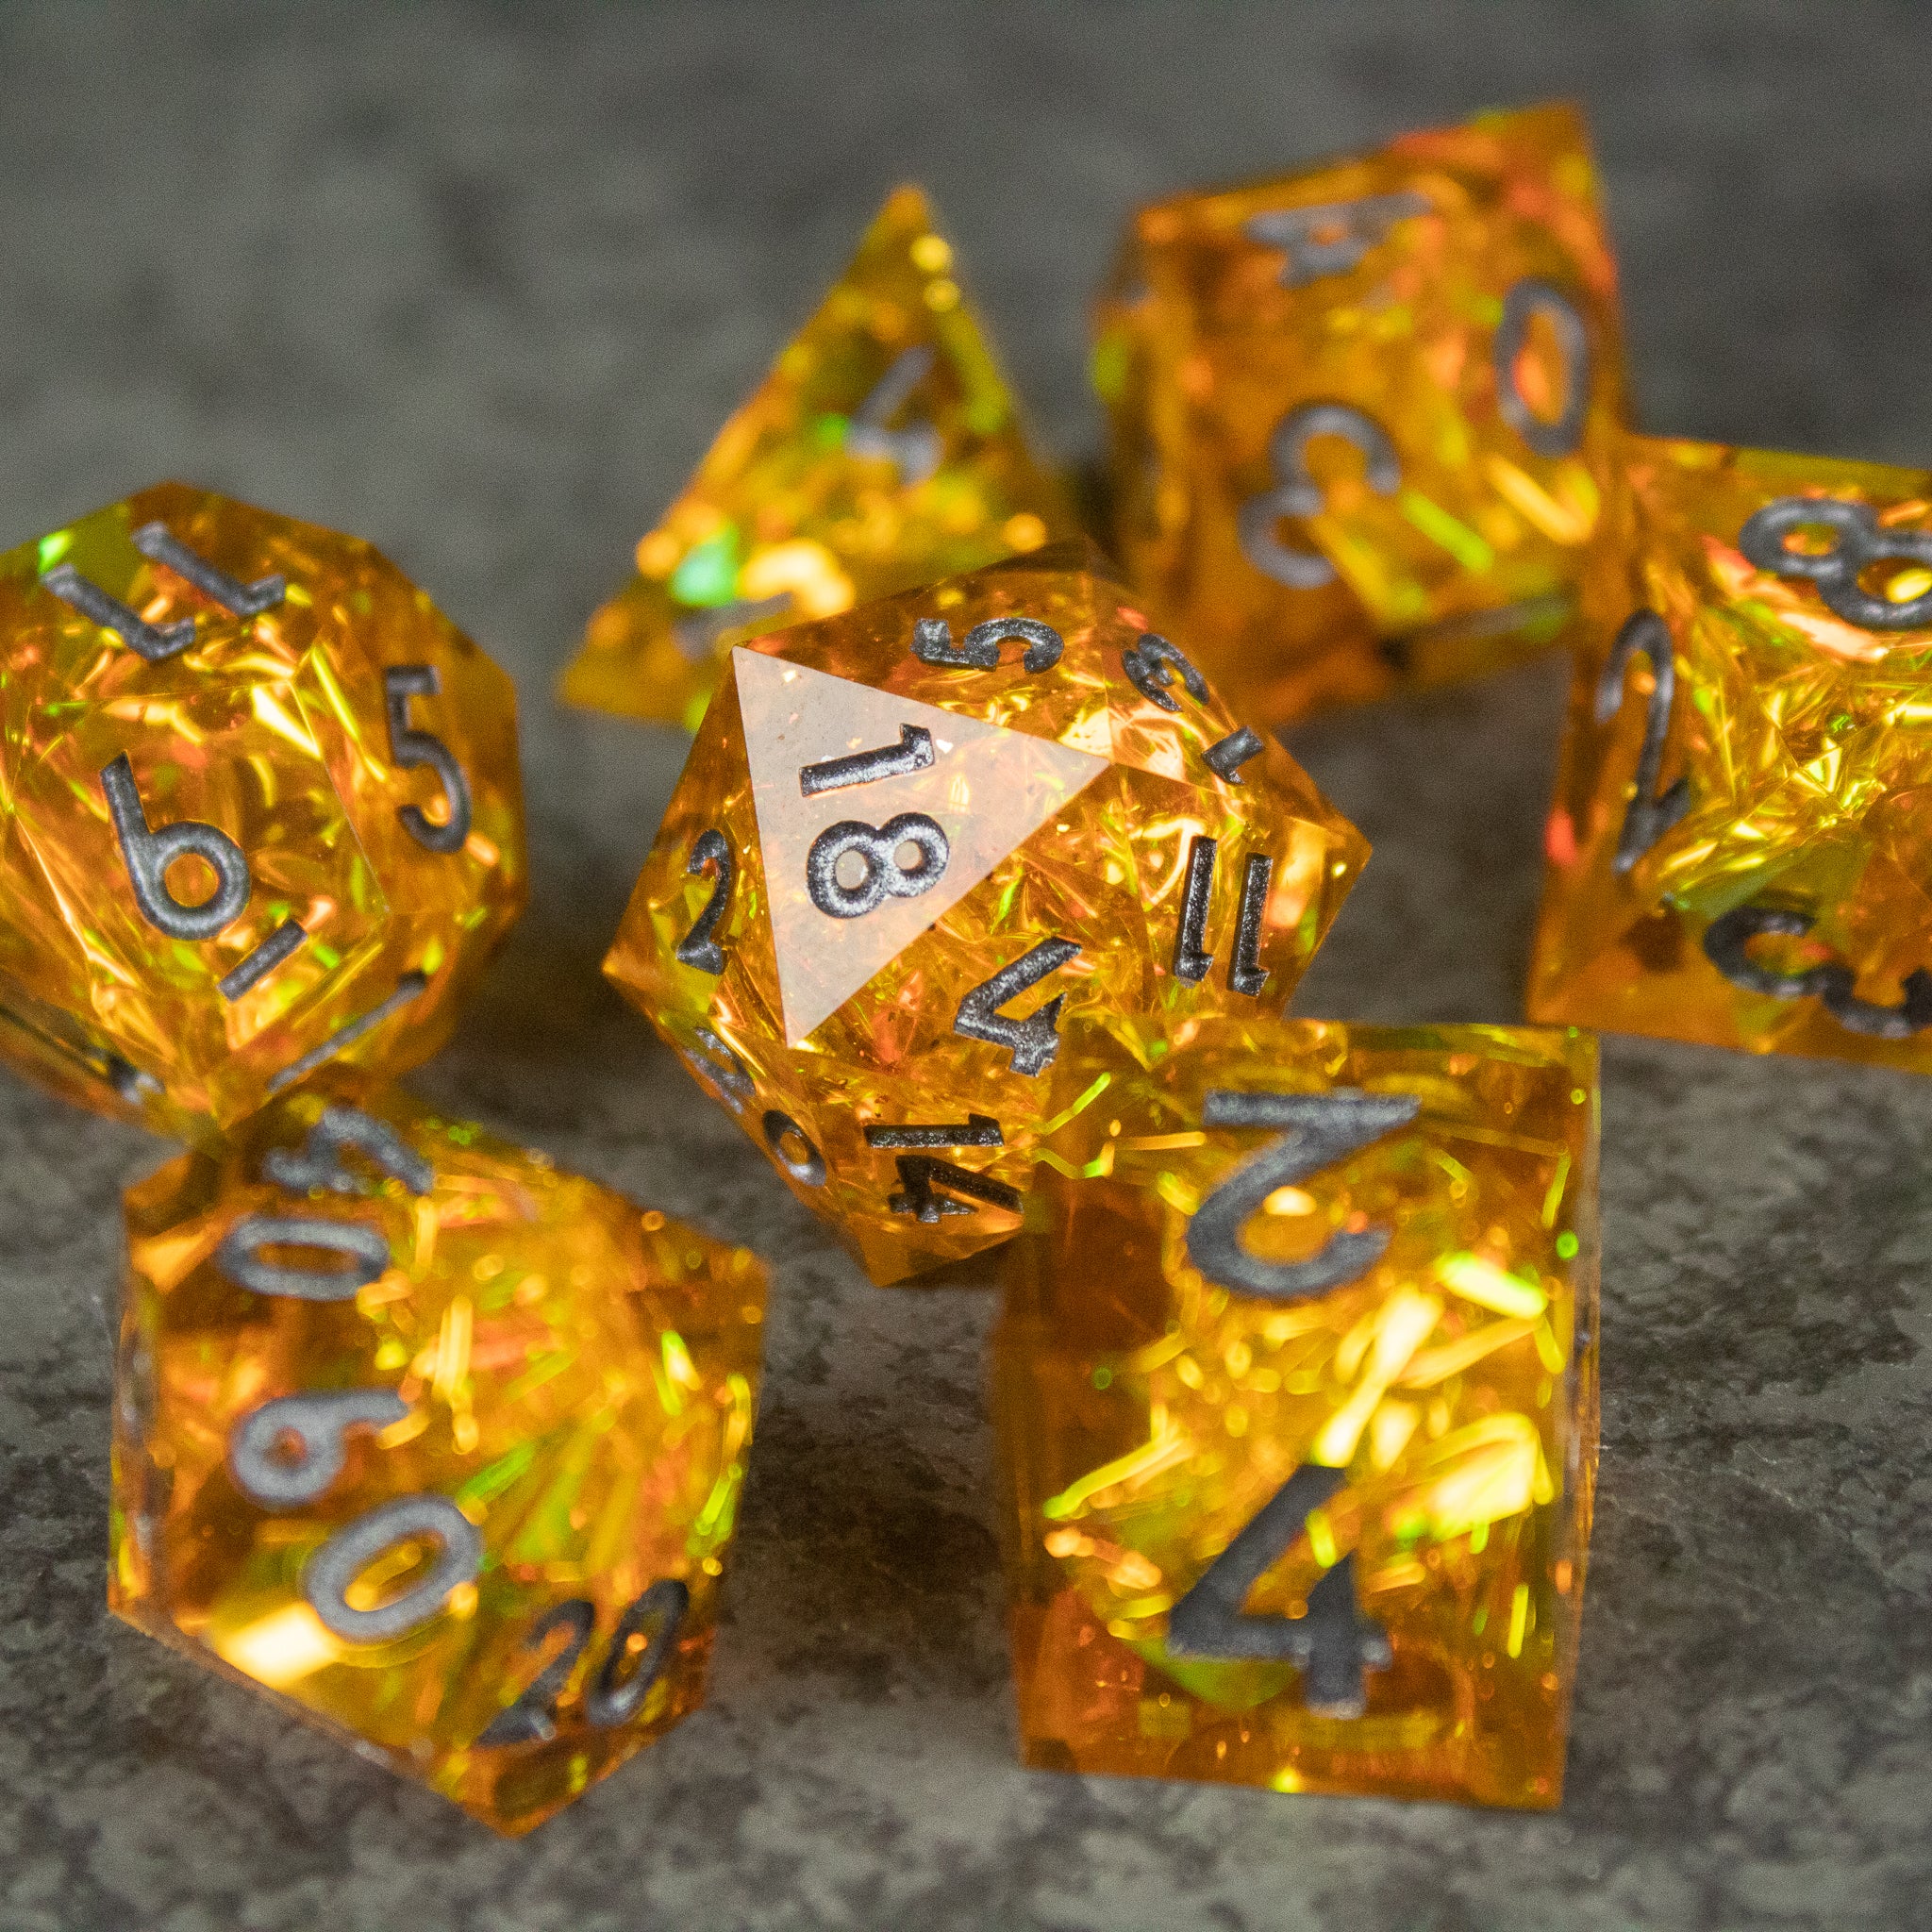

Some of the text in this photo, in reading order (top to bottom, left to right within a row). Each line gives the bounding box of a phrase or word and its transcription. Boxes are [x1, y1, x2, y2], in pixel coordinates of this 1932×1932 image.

[1238, 406, 1402, 589] 3
[1739, 496, 1932, 628] 8
[909, 617, 1065, 674] 5
[385, 664, 473, 853] 5
[798, 723, 950, 919] 18
[675, 828, 735, 976] 2
[1173, 836, 1274, 997] 11
[1702, 904, 1932, 1039] 3
[953, 937, 1083, 1077] 4
[863, 1112, 1025, 1224] 14
[1186, 1086, 1423, 1299] 2
[1166, 1462, 1393, 1720] 4
